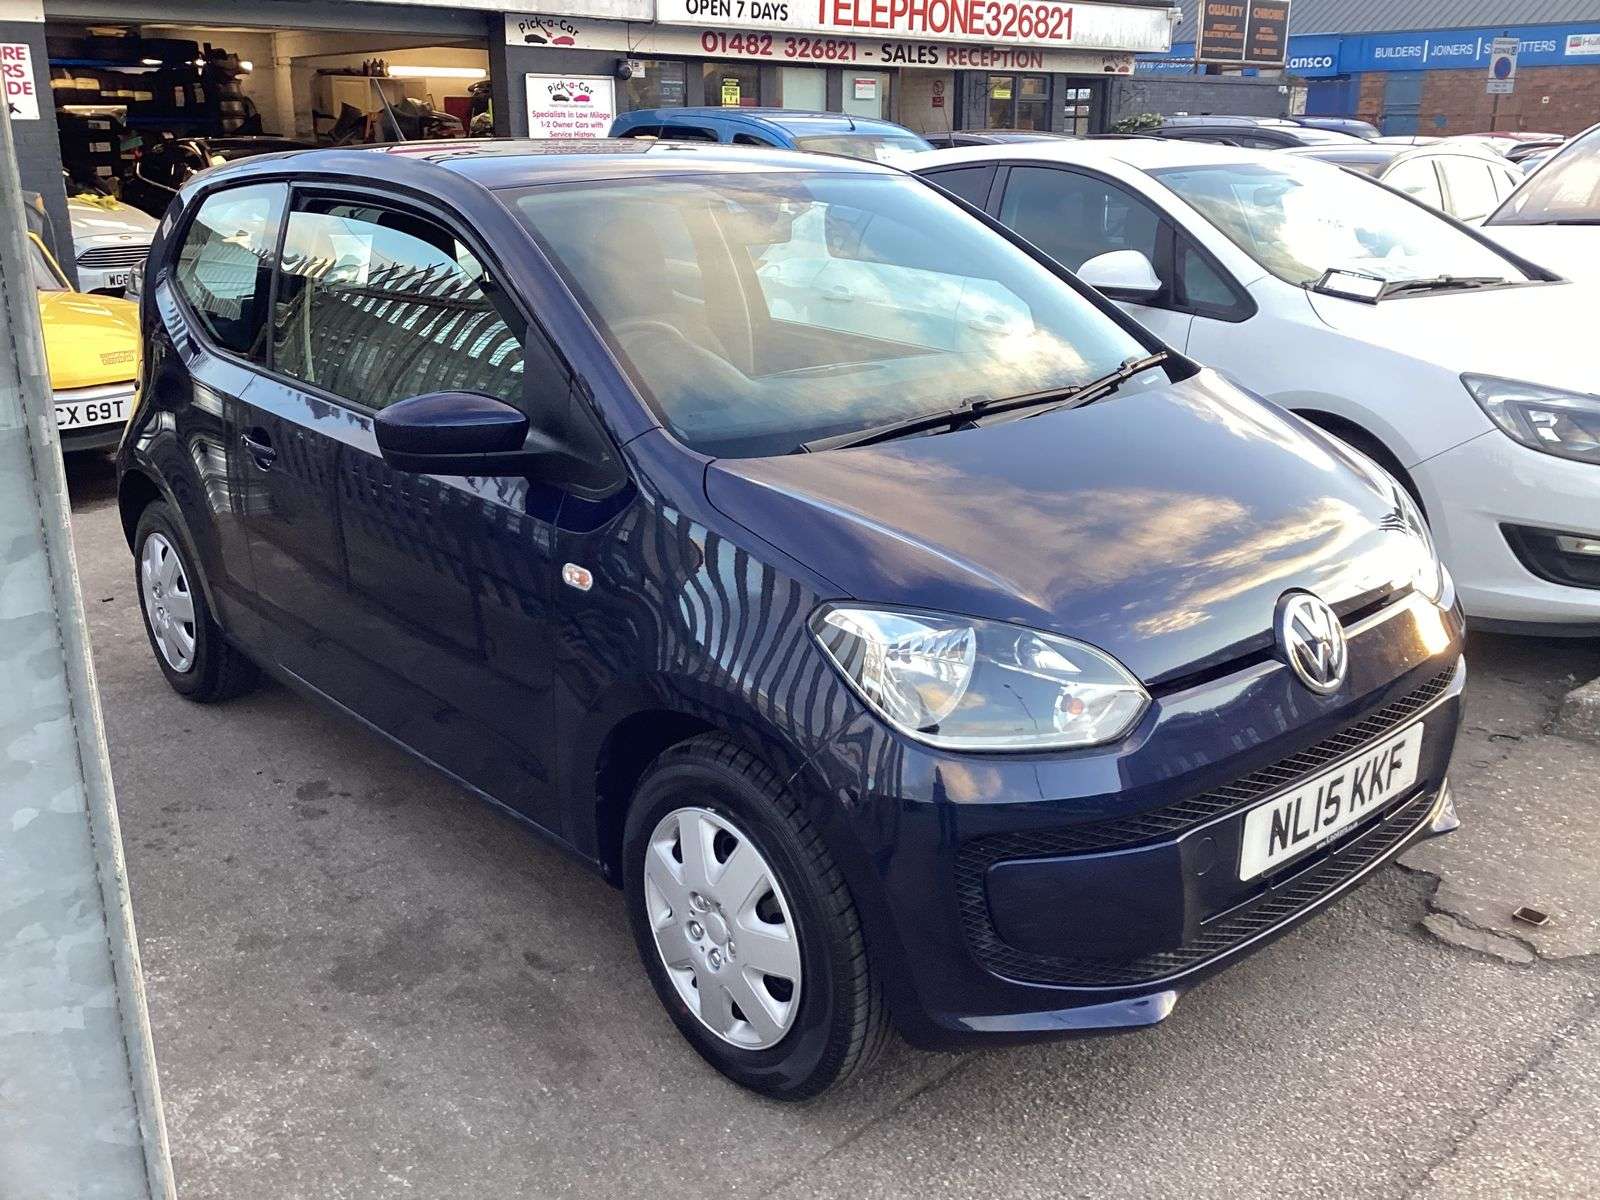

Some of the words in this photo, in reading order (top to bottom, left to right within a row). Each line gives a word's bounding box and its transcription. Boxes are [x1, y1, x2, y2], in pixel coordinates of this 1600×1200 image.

[685, 0, 731, 18] OPEN
[736, 0, 745, 18] 7
[751, 2, 788, 21] DAYS
[1208, 4, 1244, 17] QUALITY
[519, 17, 579, 36] Pick-a-Car
[0, 46, 26, 60] RE
[701, 31, 773, 55] 01482
[784, 37, 857, 60] 326821
[881, 42, 939, 64] SALES
[946, 47, 1043, 68] RECEPTION
[1375, 45, 1421, 58] BUILDERS
[1431, 44, 1473, 56] JOINERS
[1286, 56, 1332, 68] ansco
[548, 81, 594, 94] Pick-a-Car
[532, 110, 566, 119] Specialists
[86, 400, 123, 421] 69T
[1269, 775, 1345, 856] NL15
[1350, 740, 1406, 812] KKF
